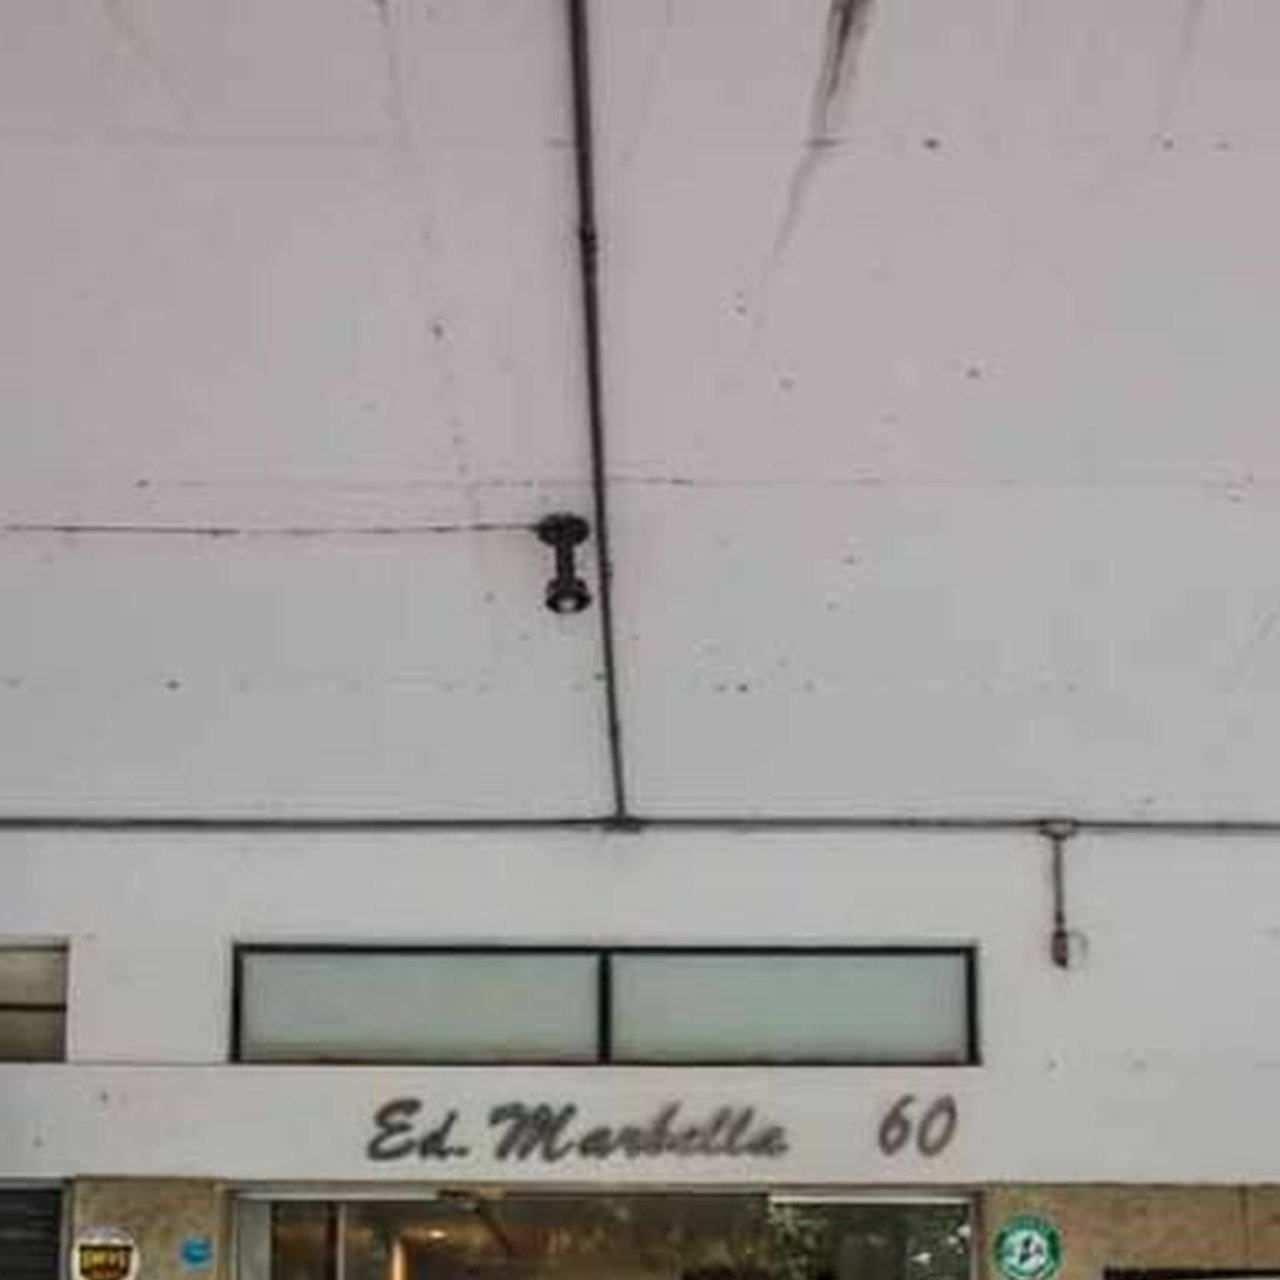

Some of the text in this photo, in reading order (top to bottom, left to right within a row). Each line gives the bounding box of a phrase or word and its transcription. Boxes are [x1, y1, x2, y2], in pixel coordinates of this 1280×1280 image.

[366, 1094, 959, 1164] Ed. Marbella 60
